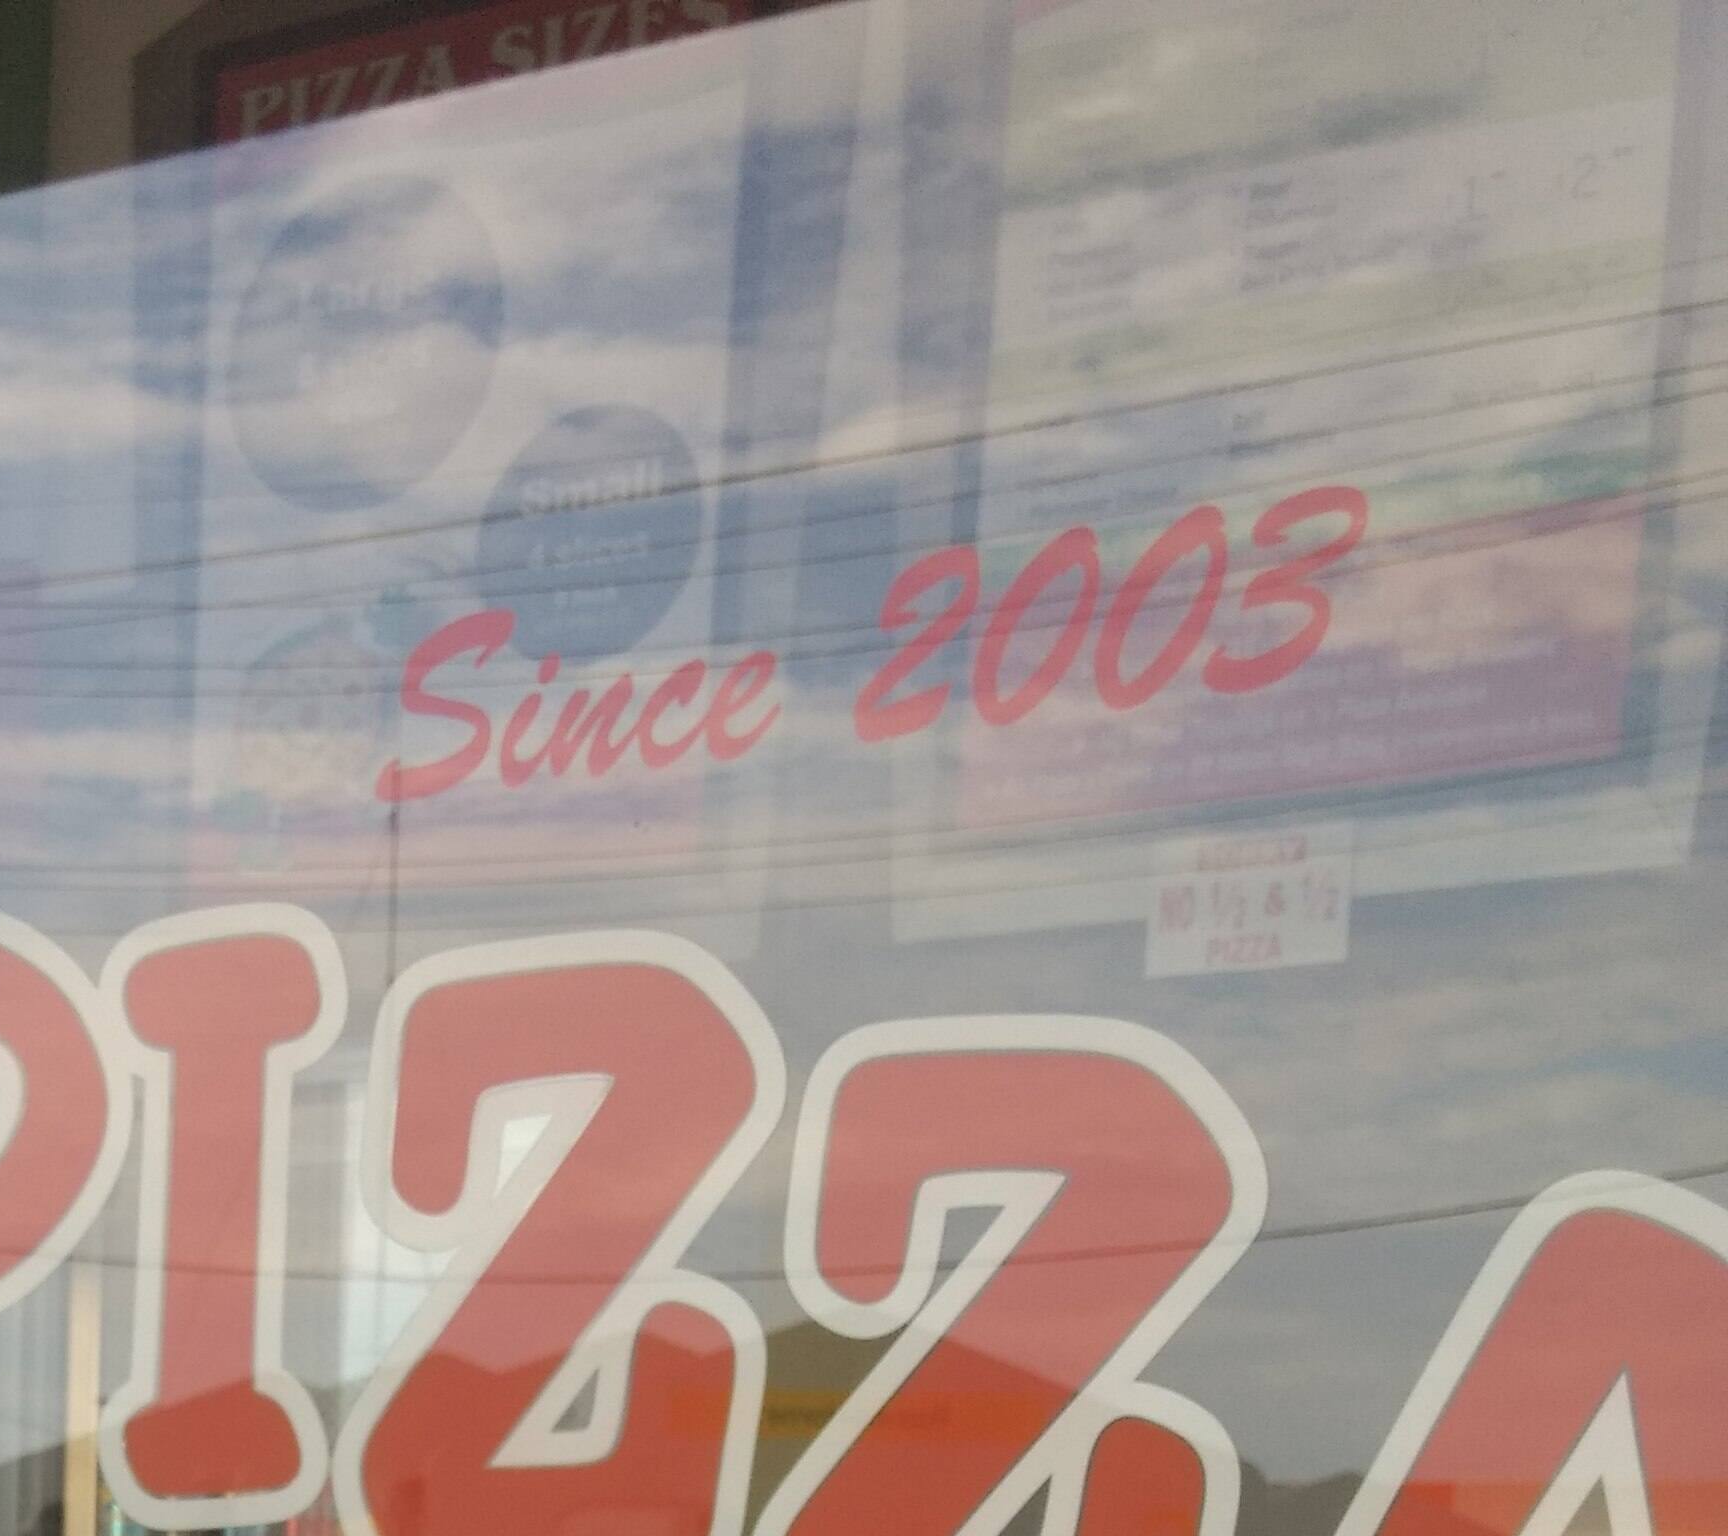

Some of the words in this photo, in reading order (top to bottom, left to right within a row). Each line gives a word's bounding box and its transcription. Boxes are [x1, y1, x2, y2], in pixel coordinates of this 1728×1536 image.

[233, 44, 459, 139] PIZZA
[375, 609, 781, 802] Since
[853, 486, 1369, 744] 2003
